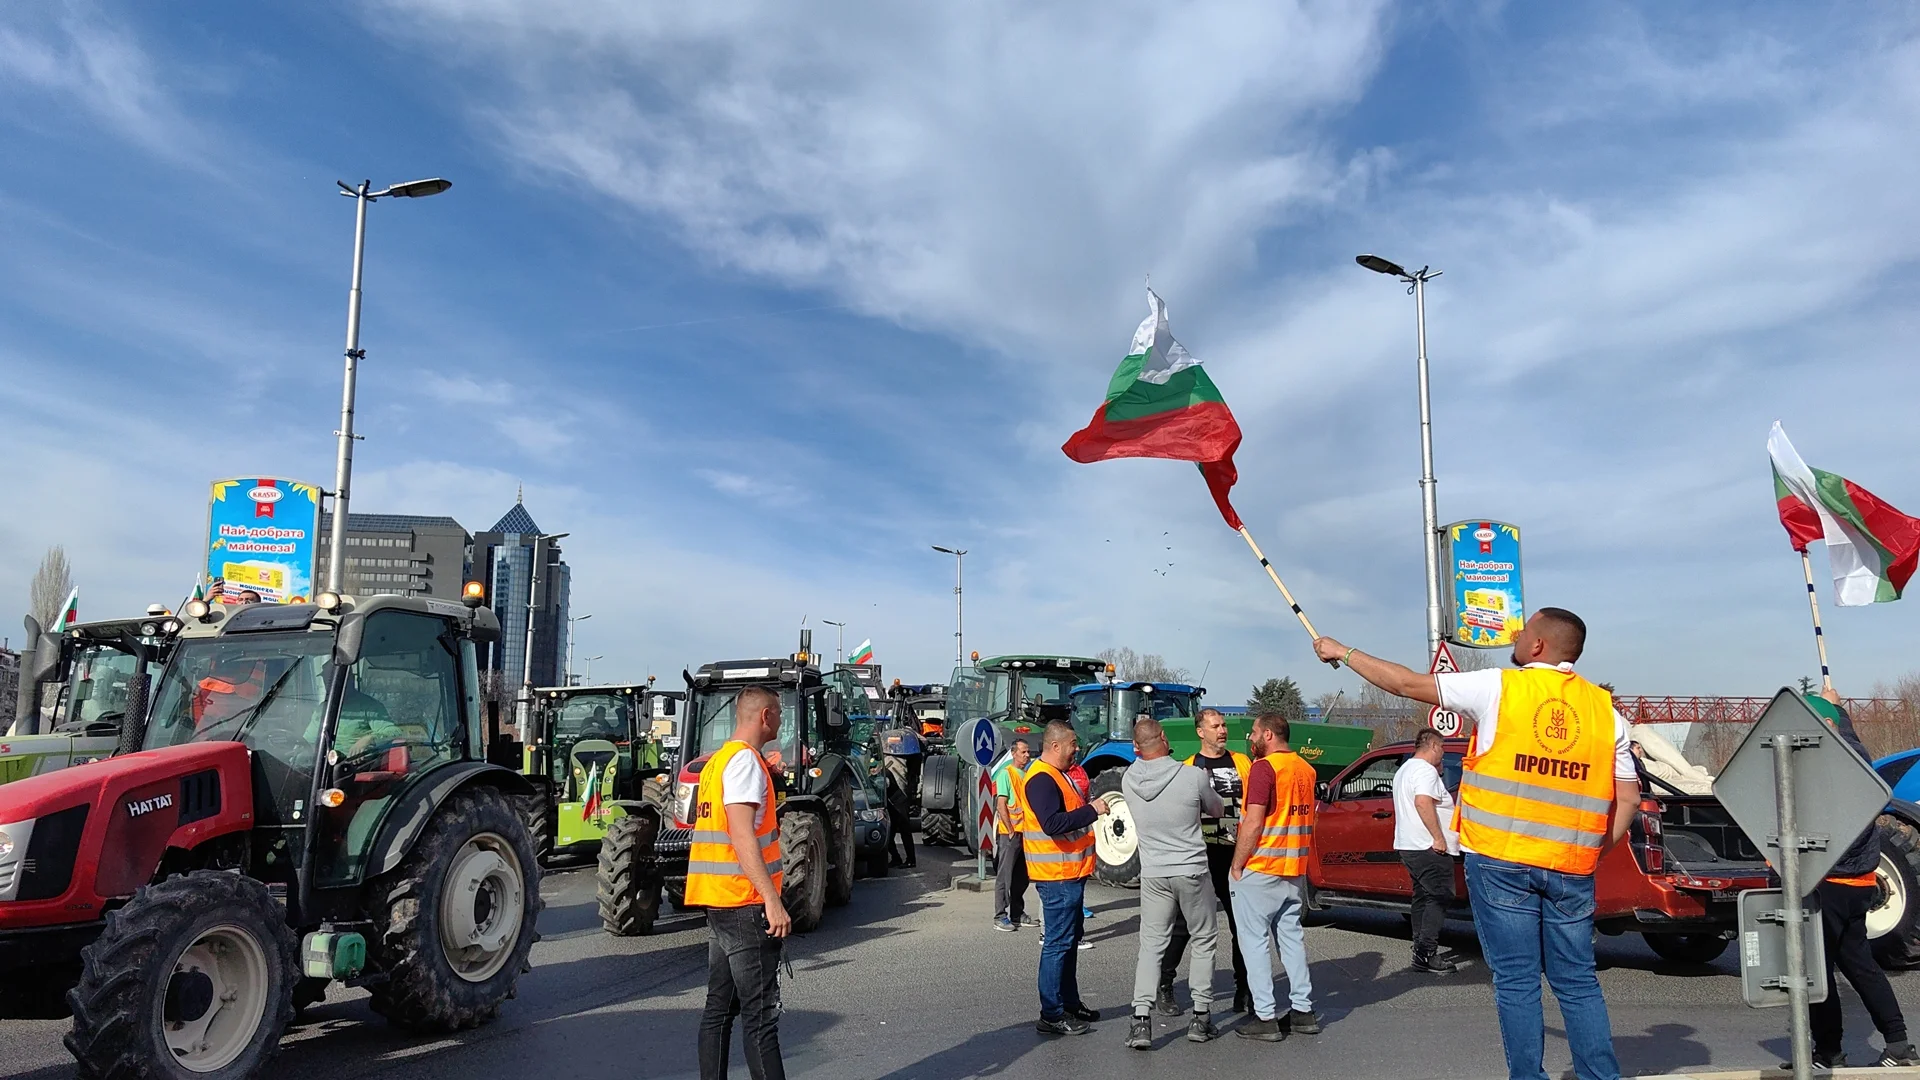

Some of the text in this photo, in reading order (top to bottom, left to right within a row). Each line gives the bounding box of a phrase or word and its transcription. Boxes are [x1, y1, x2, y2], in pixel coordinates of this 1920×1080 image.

[221, 525, 304, 539] Най-добрата
[228, 543, 295, 553] майонеза!
[1460, 560, 1513, 571] Най-добрата
[1466, 573, 1509, 582] майонеза!
[1436, 712, 1455, 730] 30
[1534, 729, 1540, 740] НА
[1545, 725, 1567, 740] СЗП
[1514, 753, 1591, 781] ПРОТЕСТ
[128, 794, 173, 817] HATTAT
